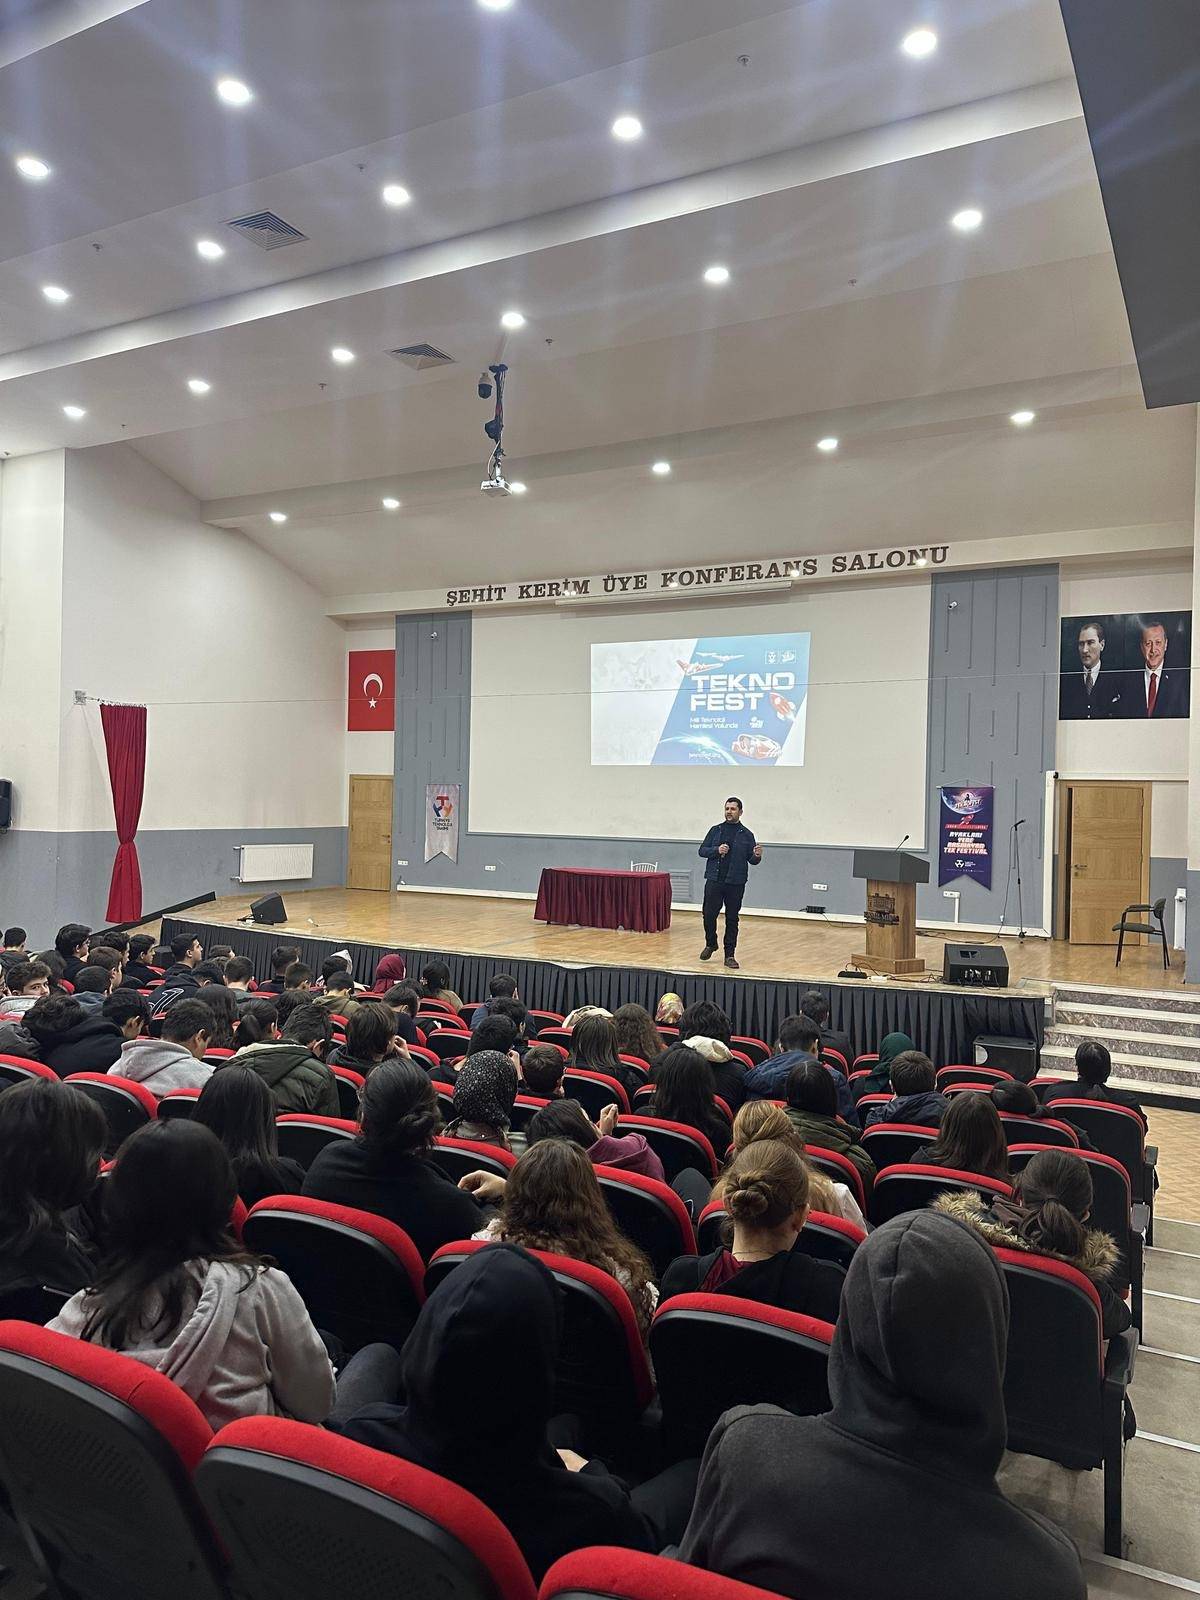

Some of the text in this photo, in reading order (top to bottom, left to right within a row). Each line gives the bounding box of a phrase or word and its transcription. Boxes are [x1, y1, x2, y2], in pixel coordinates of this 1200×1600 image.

[446, 545, 950, 606] ŞEHİT KERİM ÜYE KONFERANS SALONU
[691, 672, 795, 692] TEKNO
[690, 693, 764, 712] FEST
